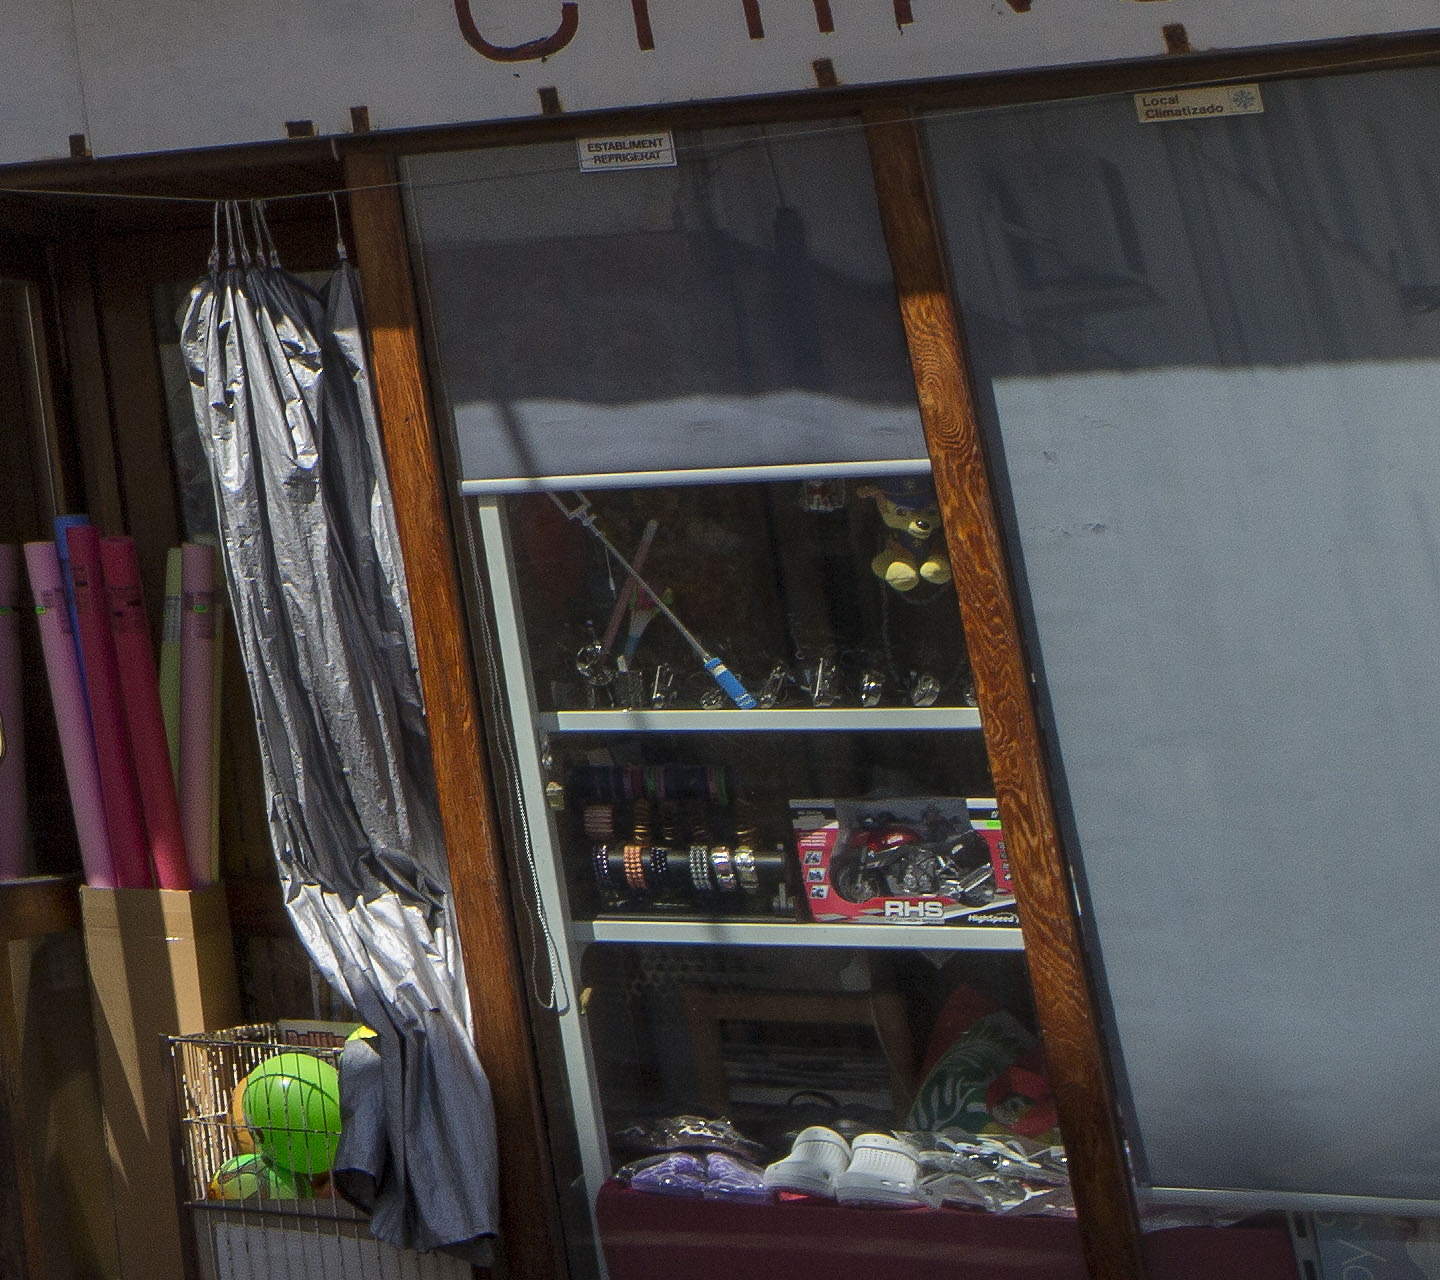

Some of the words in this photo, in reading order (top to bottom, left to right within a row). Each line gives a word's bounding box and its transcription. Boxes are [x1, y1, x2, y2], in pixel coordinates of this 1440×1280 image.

[1142, 94, 1179, 107] Local
[1145, 104, 1224, 119] Climatizado
[587, 138, 664, 152] ESTABLIMENT
[593, 151, 661, 165] REFRIGERAT
[884, 900, 944, 918] RHS
